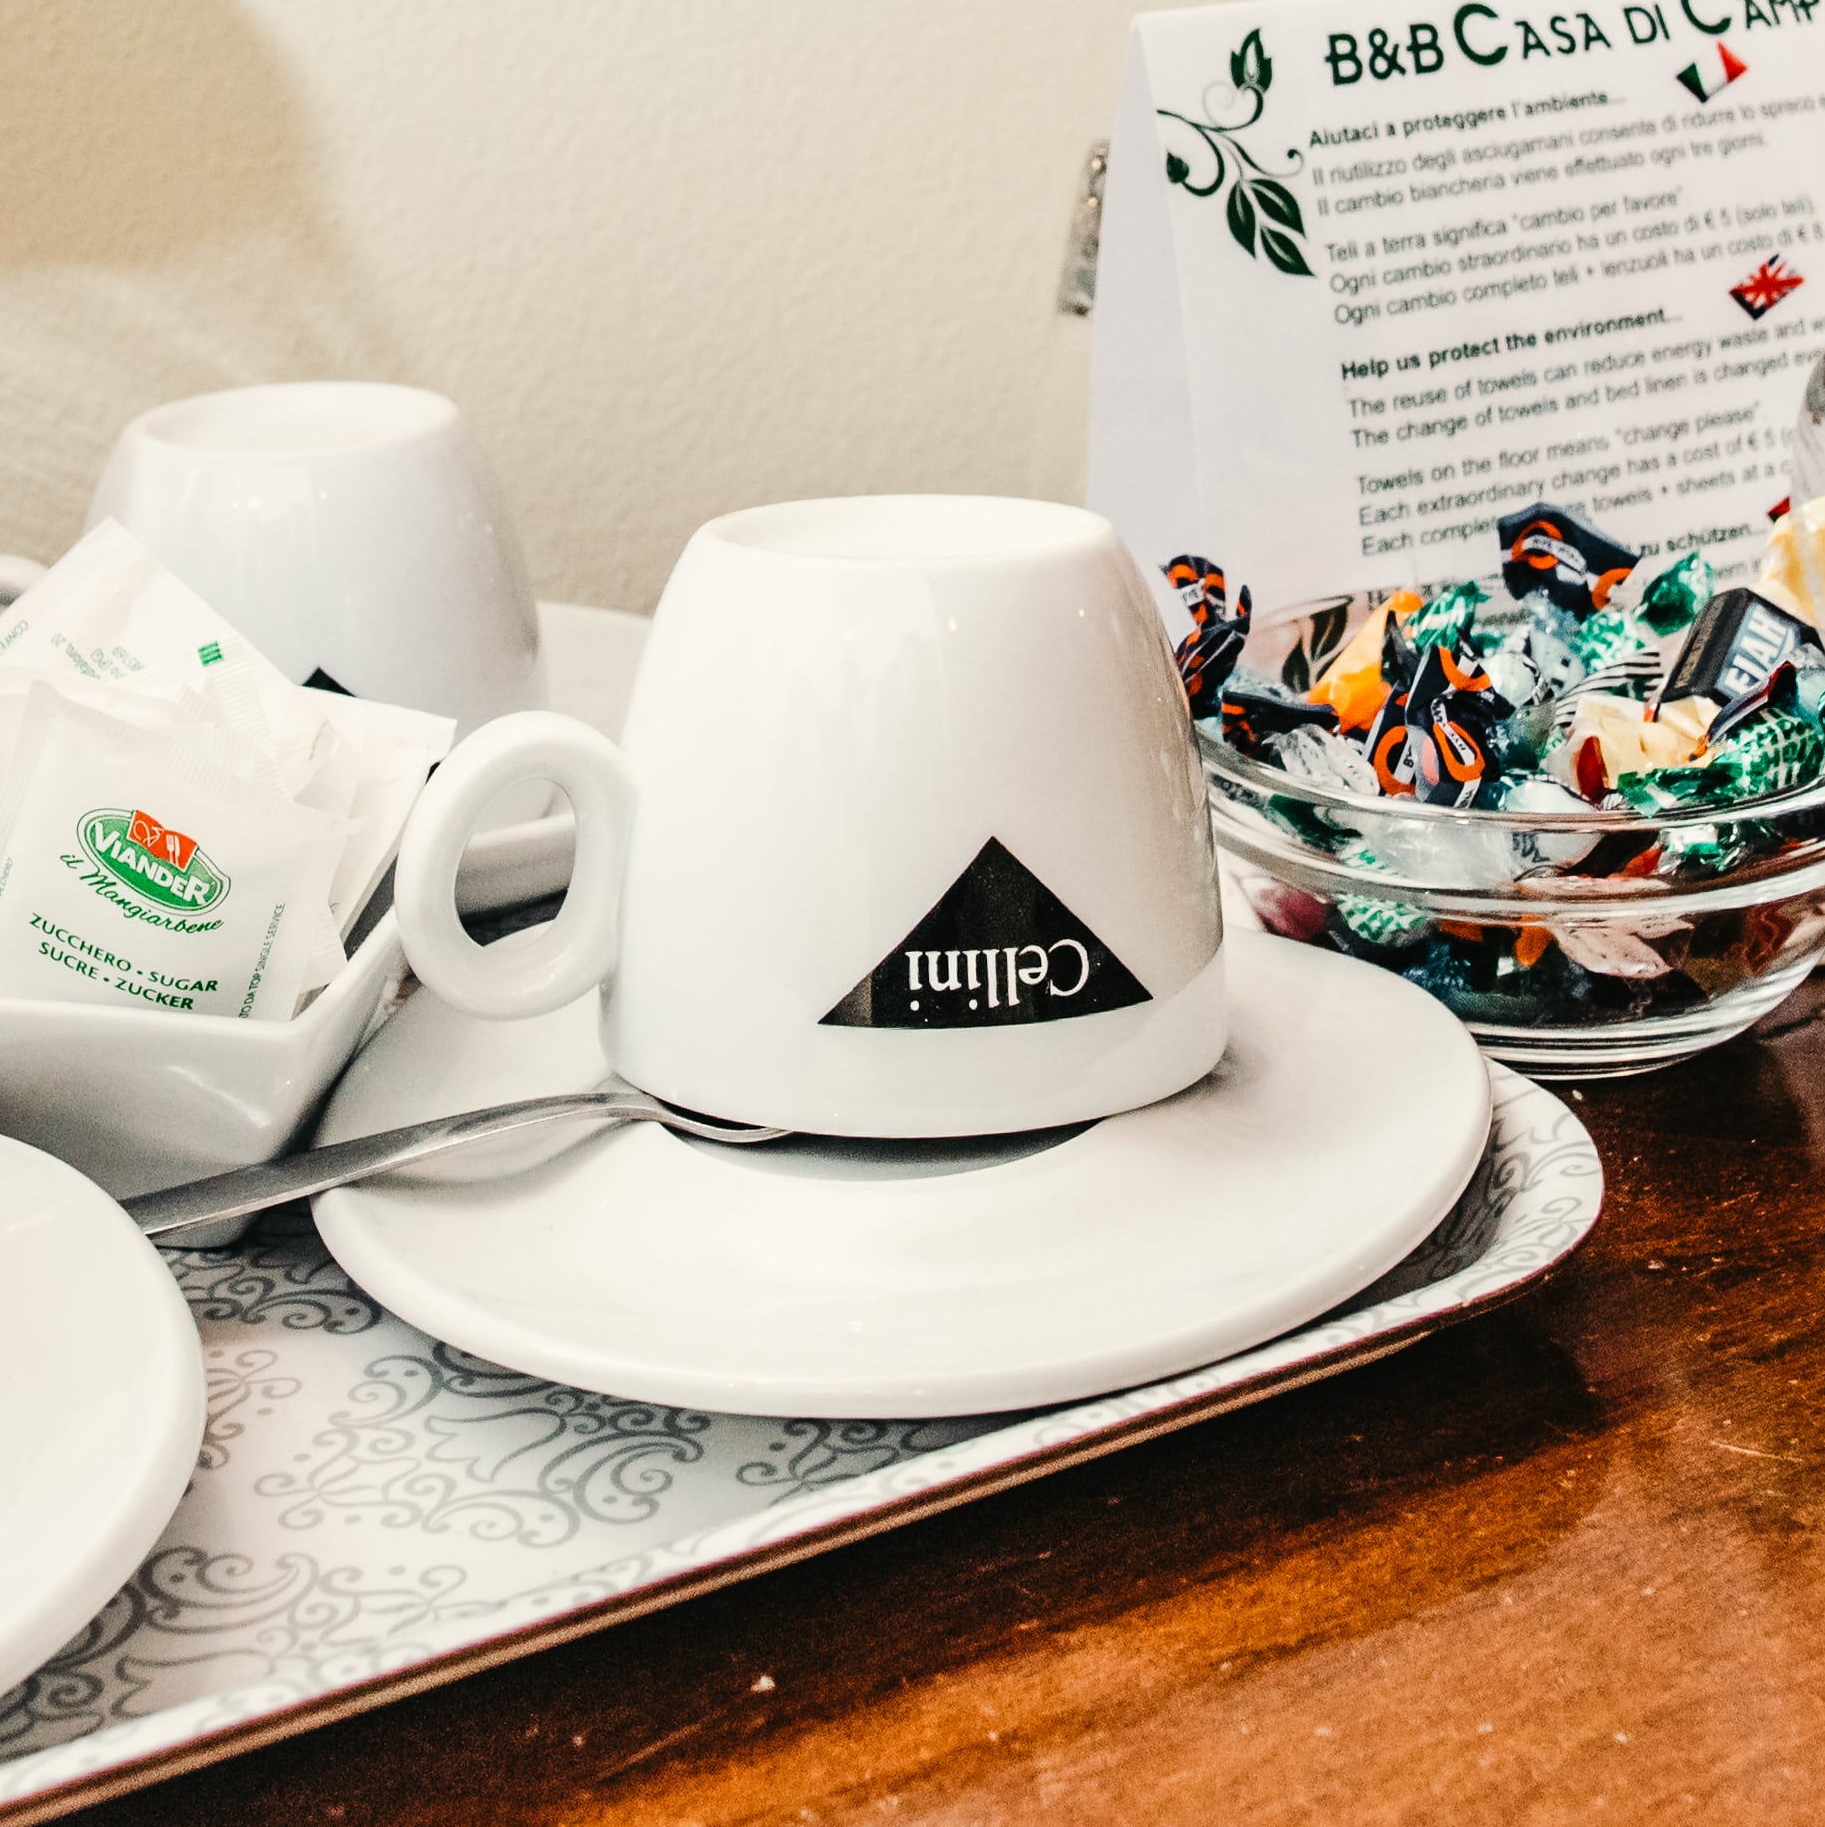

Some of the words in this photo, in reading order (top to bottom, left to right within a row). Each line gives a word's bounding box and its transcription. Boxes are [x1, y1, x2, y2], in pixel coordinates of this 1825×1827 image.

[1324, 23, 1444, 86] B&B
[1622, 3, 1671, 45] DI
[1309, 126, 1379, 149] Aiutaci
[1386, 123, 1396, 138] a
[1403, 108, 1506, 139] proteggere
[1329, 157, 1407, 184] riutilizzo
[1412, 148, 1457, 175] degli
[1462, 132, 1574, 165] asciugamani
[1579, 118, 1657, 146] consente
[1335, 189, 1404, 215] cambio
[1409, 173, 1507, 204] biancheria
[1512, 165, 1559, 185] viene
[1564, 148, 1645, 177] effettuato
[1650, 143, 1686, 168] ogni
[1326, 241, 1359, 264] Teli
[1365, 242, 1375, 258] a
[1382, 232, 1426, 256] terra
[1432, 218, 1508, 248] significa
[1590, 201, 1617, 222] per
[1329, 270, 1377, 297] Ogni
[1382, 257, 1452, 286] cambio
[1457, 237, 1572, 272] straordinario
[1577, 232, 1600, 251] ha
[1605, 229, 1627, 248] un
[1632, 219, 1679, 242] costo
[1334, 302, 1381, 326] Ogni
[1386, 287, 1457, 317] cambio
[1462, 271, 1548, 304] completo
[1553, 264, 1579, 286] teli
[1600, 250, 1669, 278] lenzuoli
[1673, 246, 1696, 265] ha
[1701, 242, 1722, 261] un
[1726, 232, 1774, 257] costo
[1341, 357, 1389, 380] Help
[1396, 353, 1421, 373] us
[1428, 337, 1500, 370] protect
[1506, 331, 1538, 350] the
[1349, 398, 1387, 419] The
[1392, 385, 1449, 412] reuse
[1454, 379, 1473, 401] of
[1477, 369, 1538, 396] towels
[1543, 363, 1578, 384] can
[1584, 352, 1646, 378] reduce
[1652, 339, 1713, 363] energy
[1718, 328, 1769, 350] waste
[1775, 319, 1806, 340] and
[1351, 427, 1389, 450] The
[1395, 415, 1468, 441] change
[1474, 406, 1493, 428] of
[1497, 397, 1559, 424] towels
[1565, 387, 1600, 411] and
[1605, 380, 1640, 404] bed
[1645, 373, 1687, 395] linen
[1693, 369, 1708, 386] is
[1714, 351, 1789, 382] changed
[1358, 469, 1424, 496] Towels
[1431, 462, 1456, 482] on
[1462, 454, 1492, 476] the
[1498, 447, 1540, 470] floor
[1546, 433, 1610, 461] means
[1359, 501, 1411, 527] Each
[1417, 477, 1546, 517] extraordinary
[1551, 462, 1621, 491] change
[1626, 455, 1661, 474] has
[1667, 451, 1678, 468] a
[1683, 442, 1721, 465] cost
[1726, 433, 1744, 457] of
[1361, 531, 1414, 557] Each
[1592, 489, 1652, 515] towels
[1676, 470, 1736, 496] sheets
[91, 821, 210, 905] VIANDER
[79, 871, 225, 934] Mangiarbene
[29, 912, 132, 973] ZUCCHERO
[148, 970, 218, 992] SUGAR
[38, 941, 99, 980] SUCRE
[113, 977, 194, 1010] ZUCKER
[247, 971, 262, 992] TOP
[254, 937, 274, 973] SINGLE
[904, 938, 1089, 1012] Cellini
